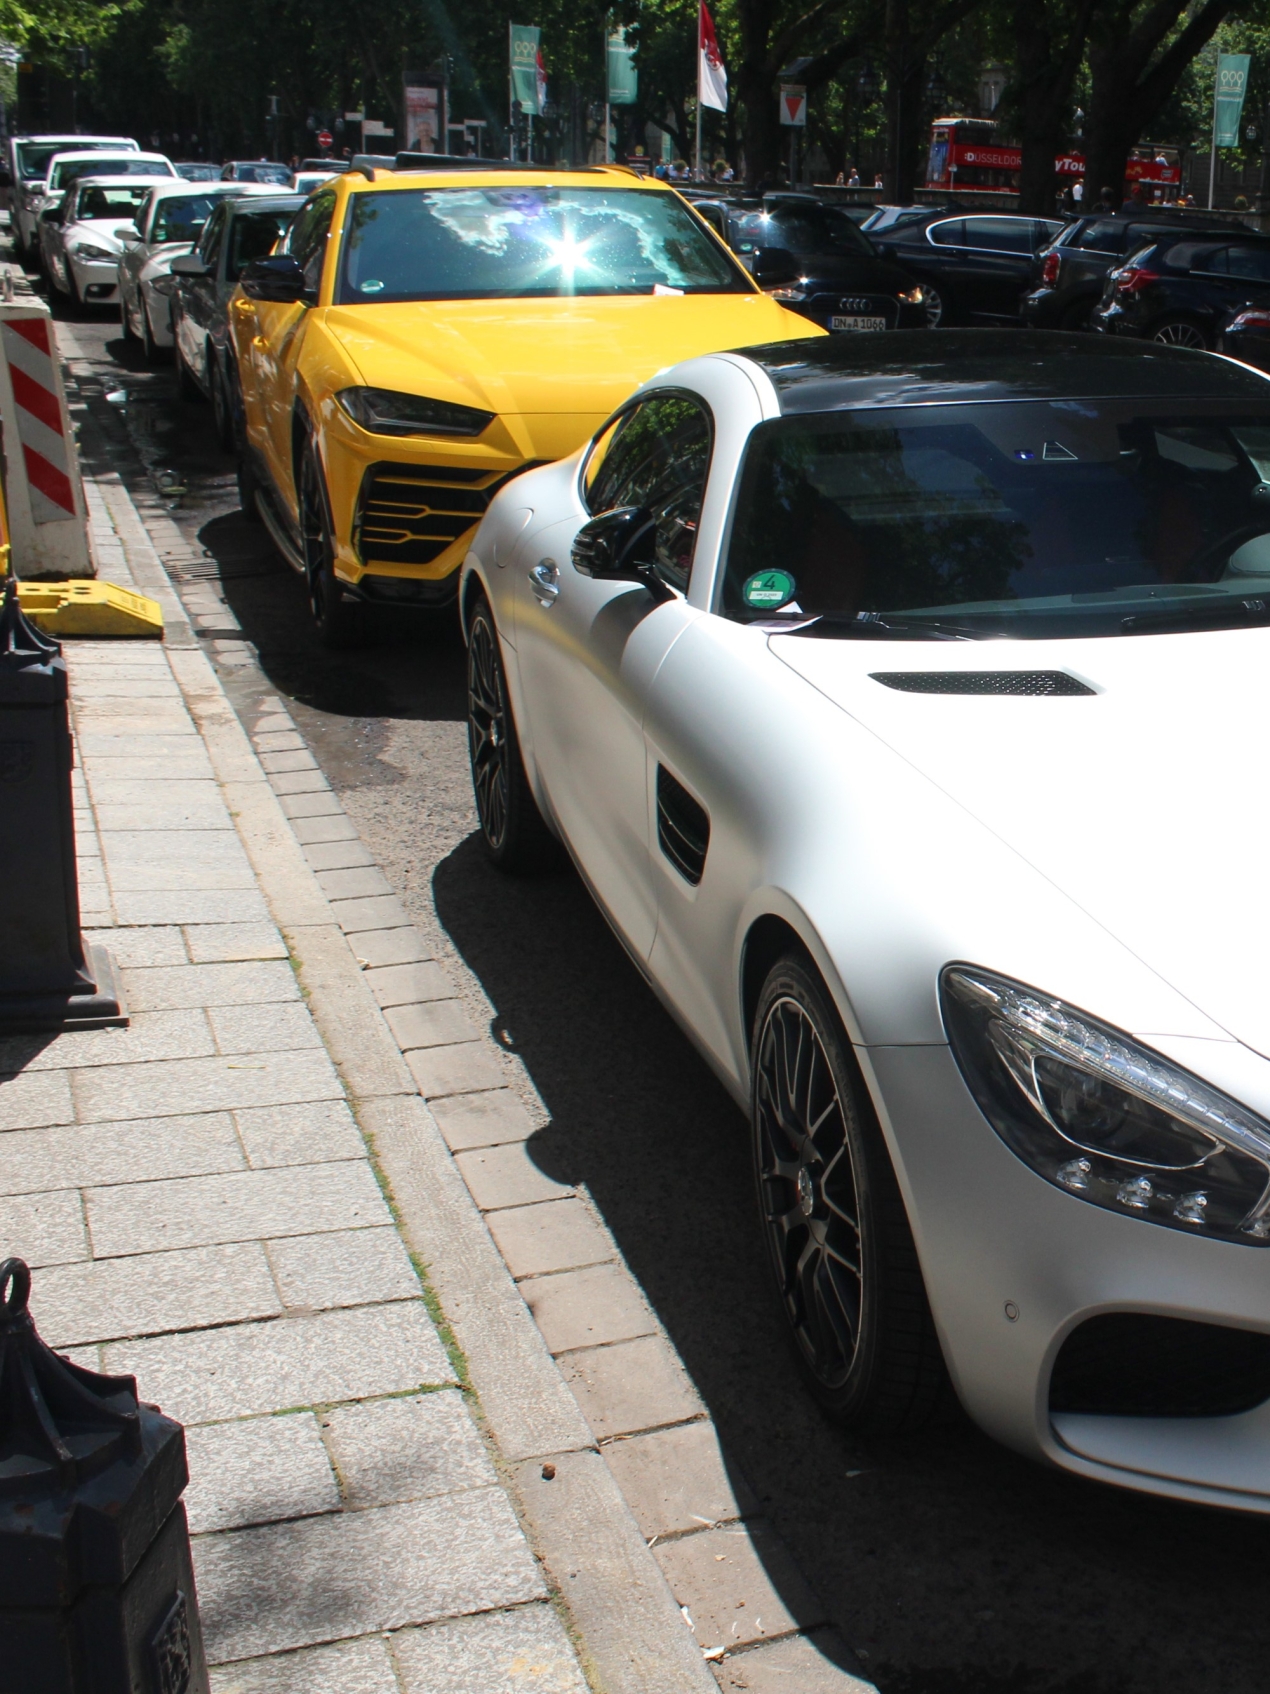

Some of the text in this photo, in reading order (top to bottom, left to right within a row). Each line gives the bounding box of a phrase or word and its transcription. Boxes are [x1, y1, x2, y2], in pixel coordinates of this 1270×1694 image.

[833, 317, 885, 331] DN A 1066
[763, 573, 776, 590] 4
